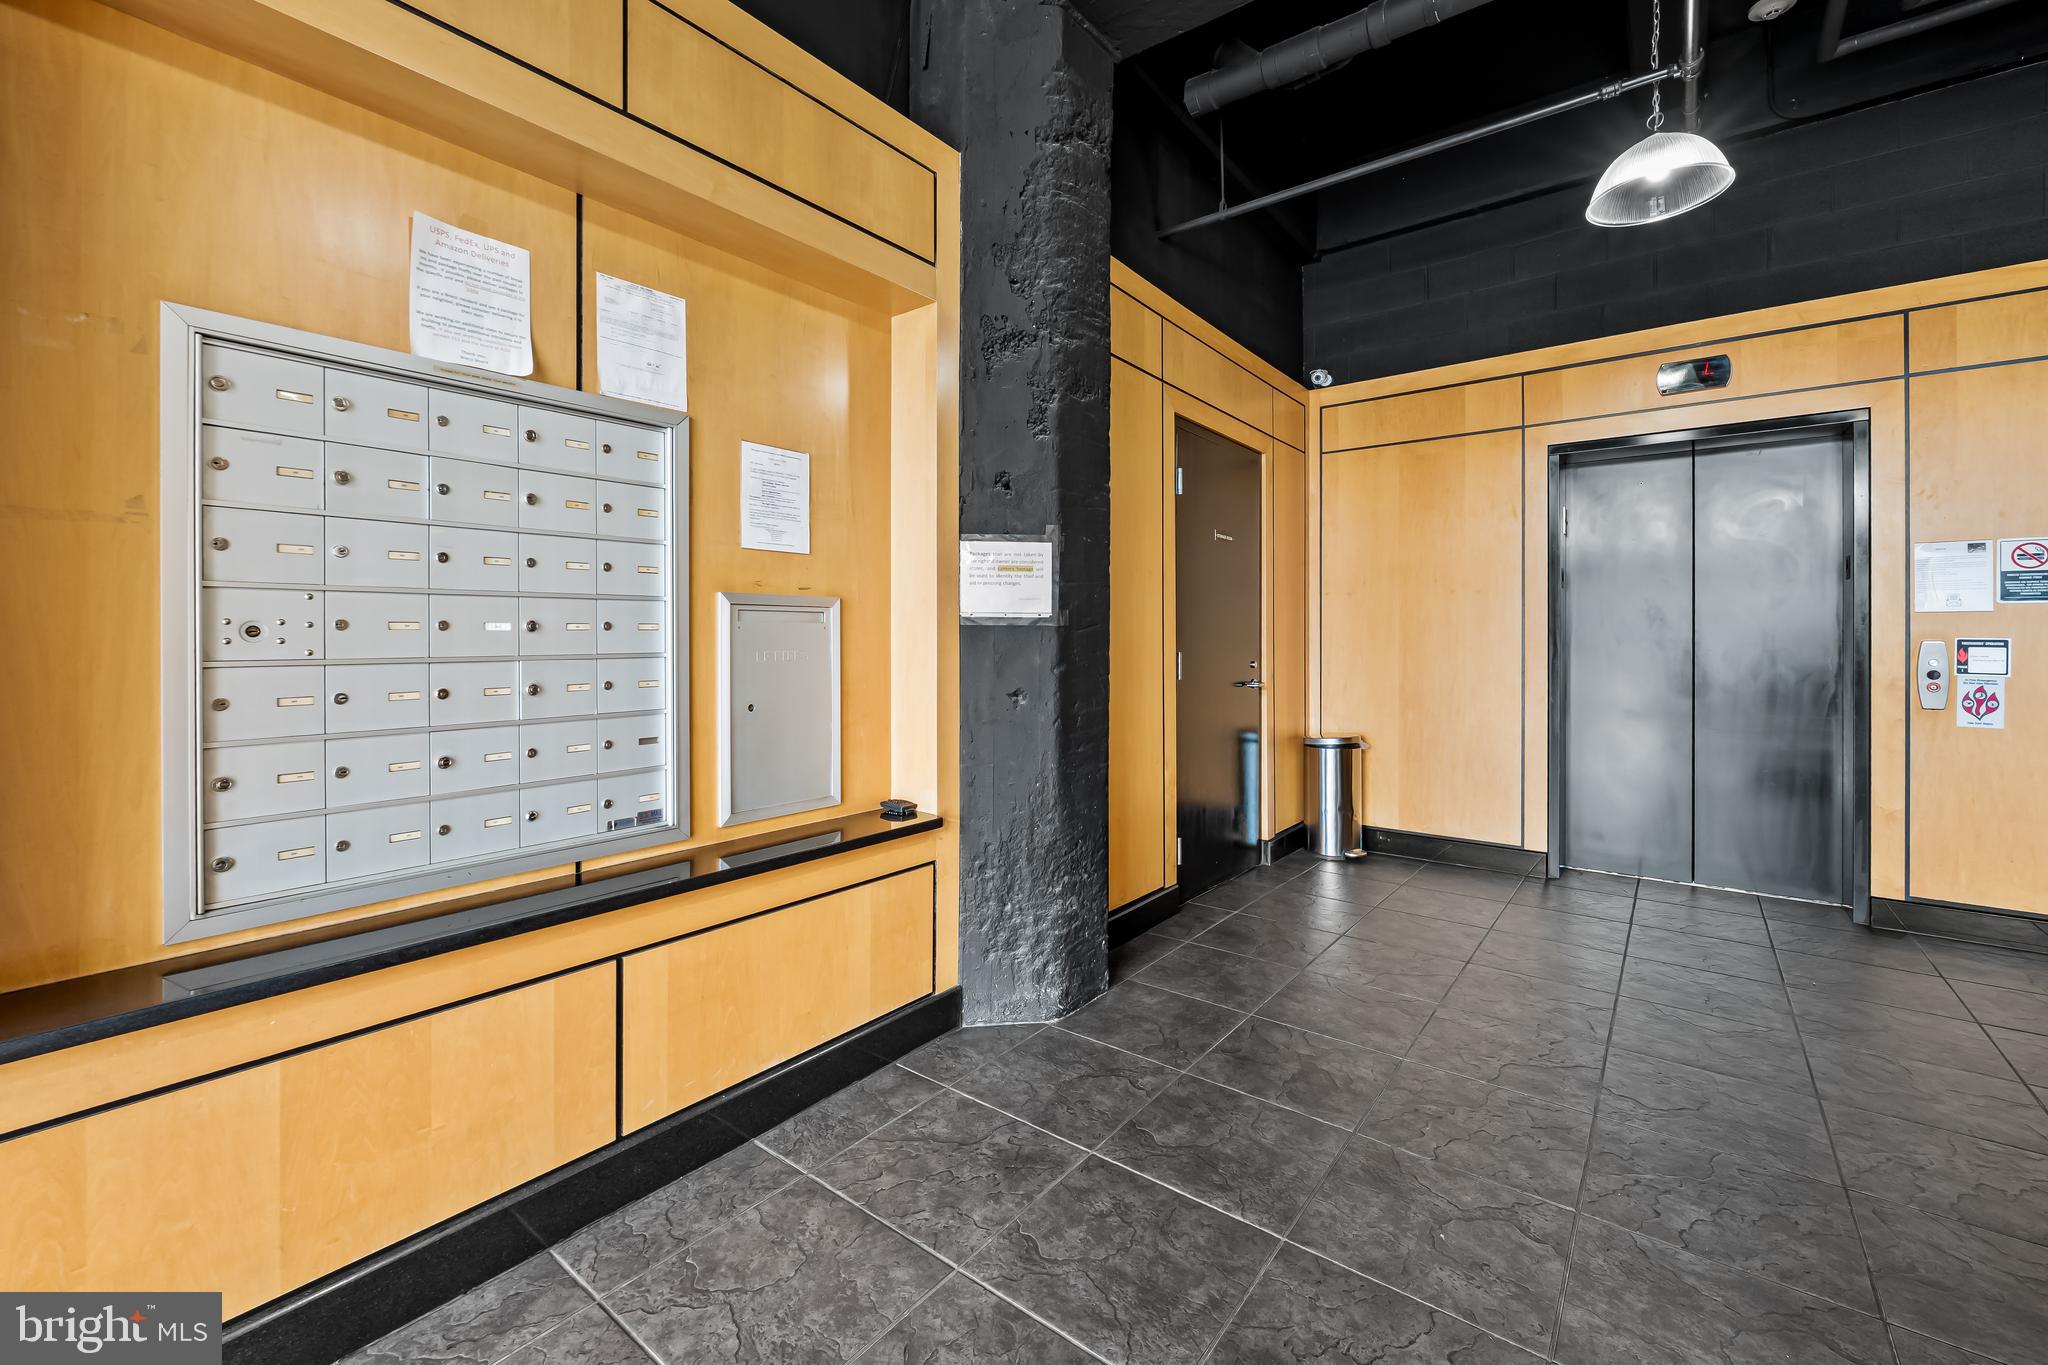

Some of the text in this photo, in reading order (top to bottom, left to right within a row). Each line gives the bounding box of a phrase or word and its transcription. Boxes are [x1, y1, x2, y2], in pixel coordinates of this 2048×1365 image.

[435, 239, 510, 268] Amazon Deliveries
[483, 243, 499, 254] UPS
[501, 247, 516, 260] and
